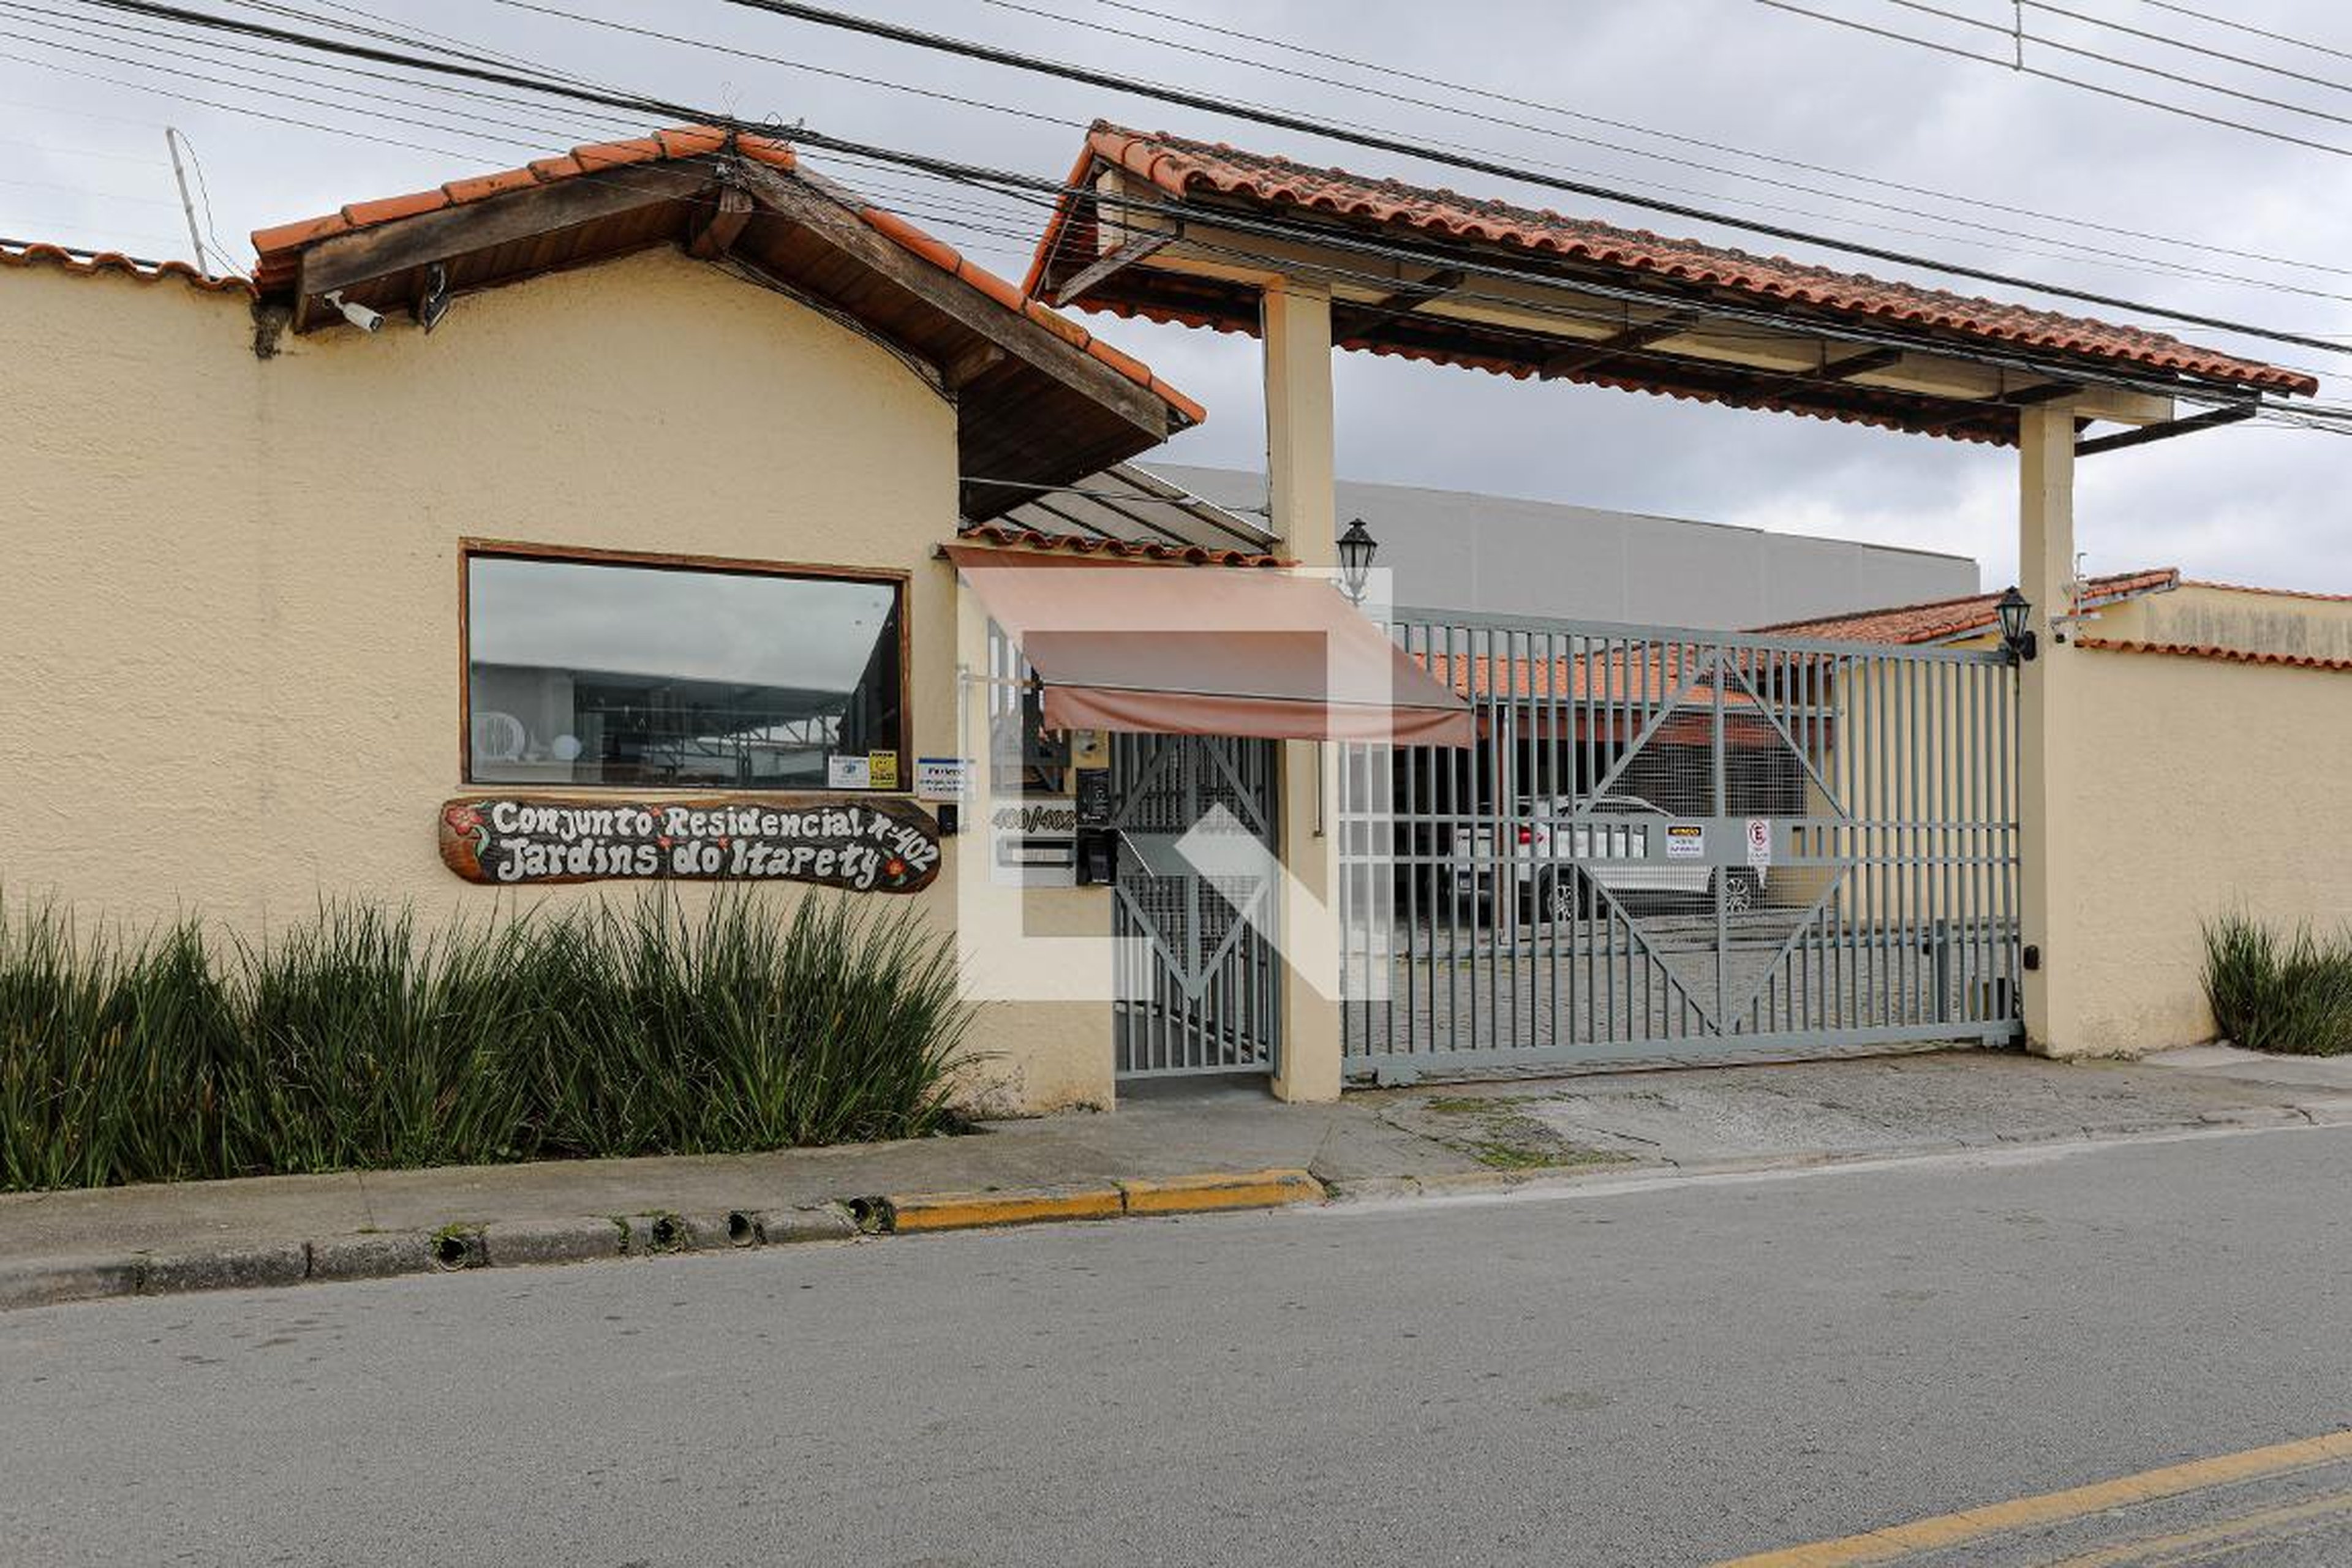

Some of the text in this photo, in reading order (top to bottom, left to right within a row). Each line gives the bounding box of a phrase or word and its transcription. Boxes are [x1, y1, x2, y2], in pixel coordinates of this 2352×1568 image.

[492, 802, 652, 842] Conjunto
[665, 807, 864, 838] Residencial
[497, 837, 658, 881] Jardins
[673, 840, 720, 874] do
